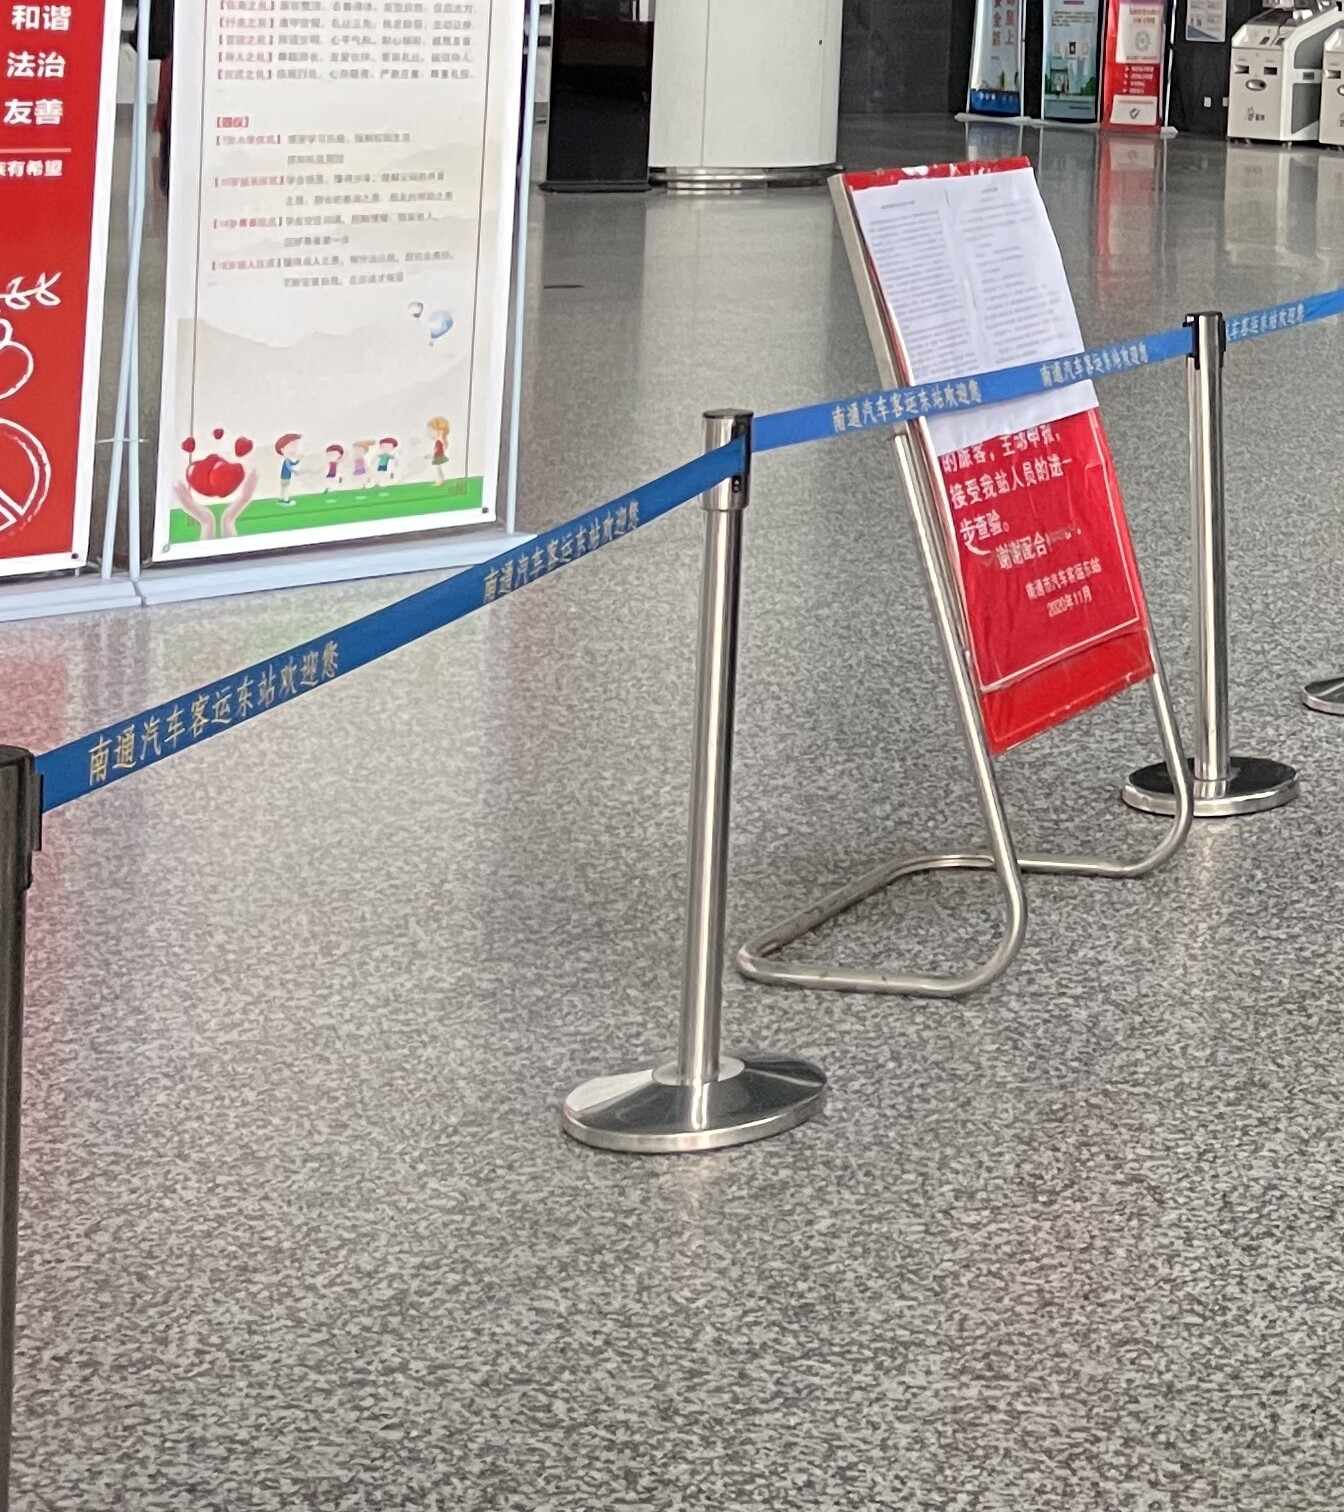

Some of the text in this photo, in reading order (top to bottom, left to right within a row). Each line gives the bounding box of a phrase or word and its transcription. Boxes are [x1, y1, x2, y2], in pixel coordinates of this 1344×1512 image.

[11, 4, 72, 32] 和谐
[6, 51, 66, 79] 法治
[3, 98, 64, 126] 友善
[88, 640, 339, 787] 南通汽车客运东站欢迎您
